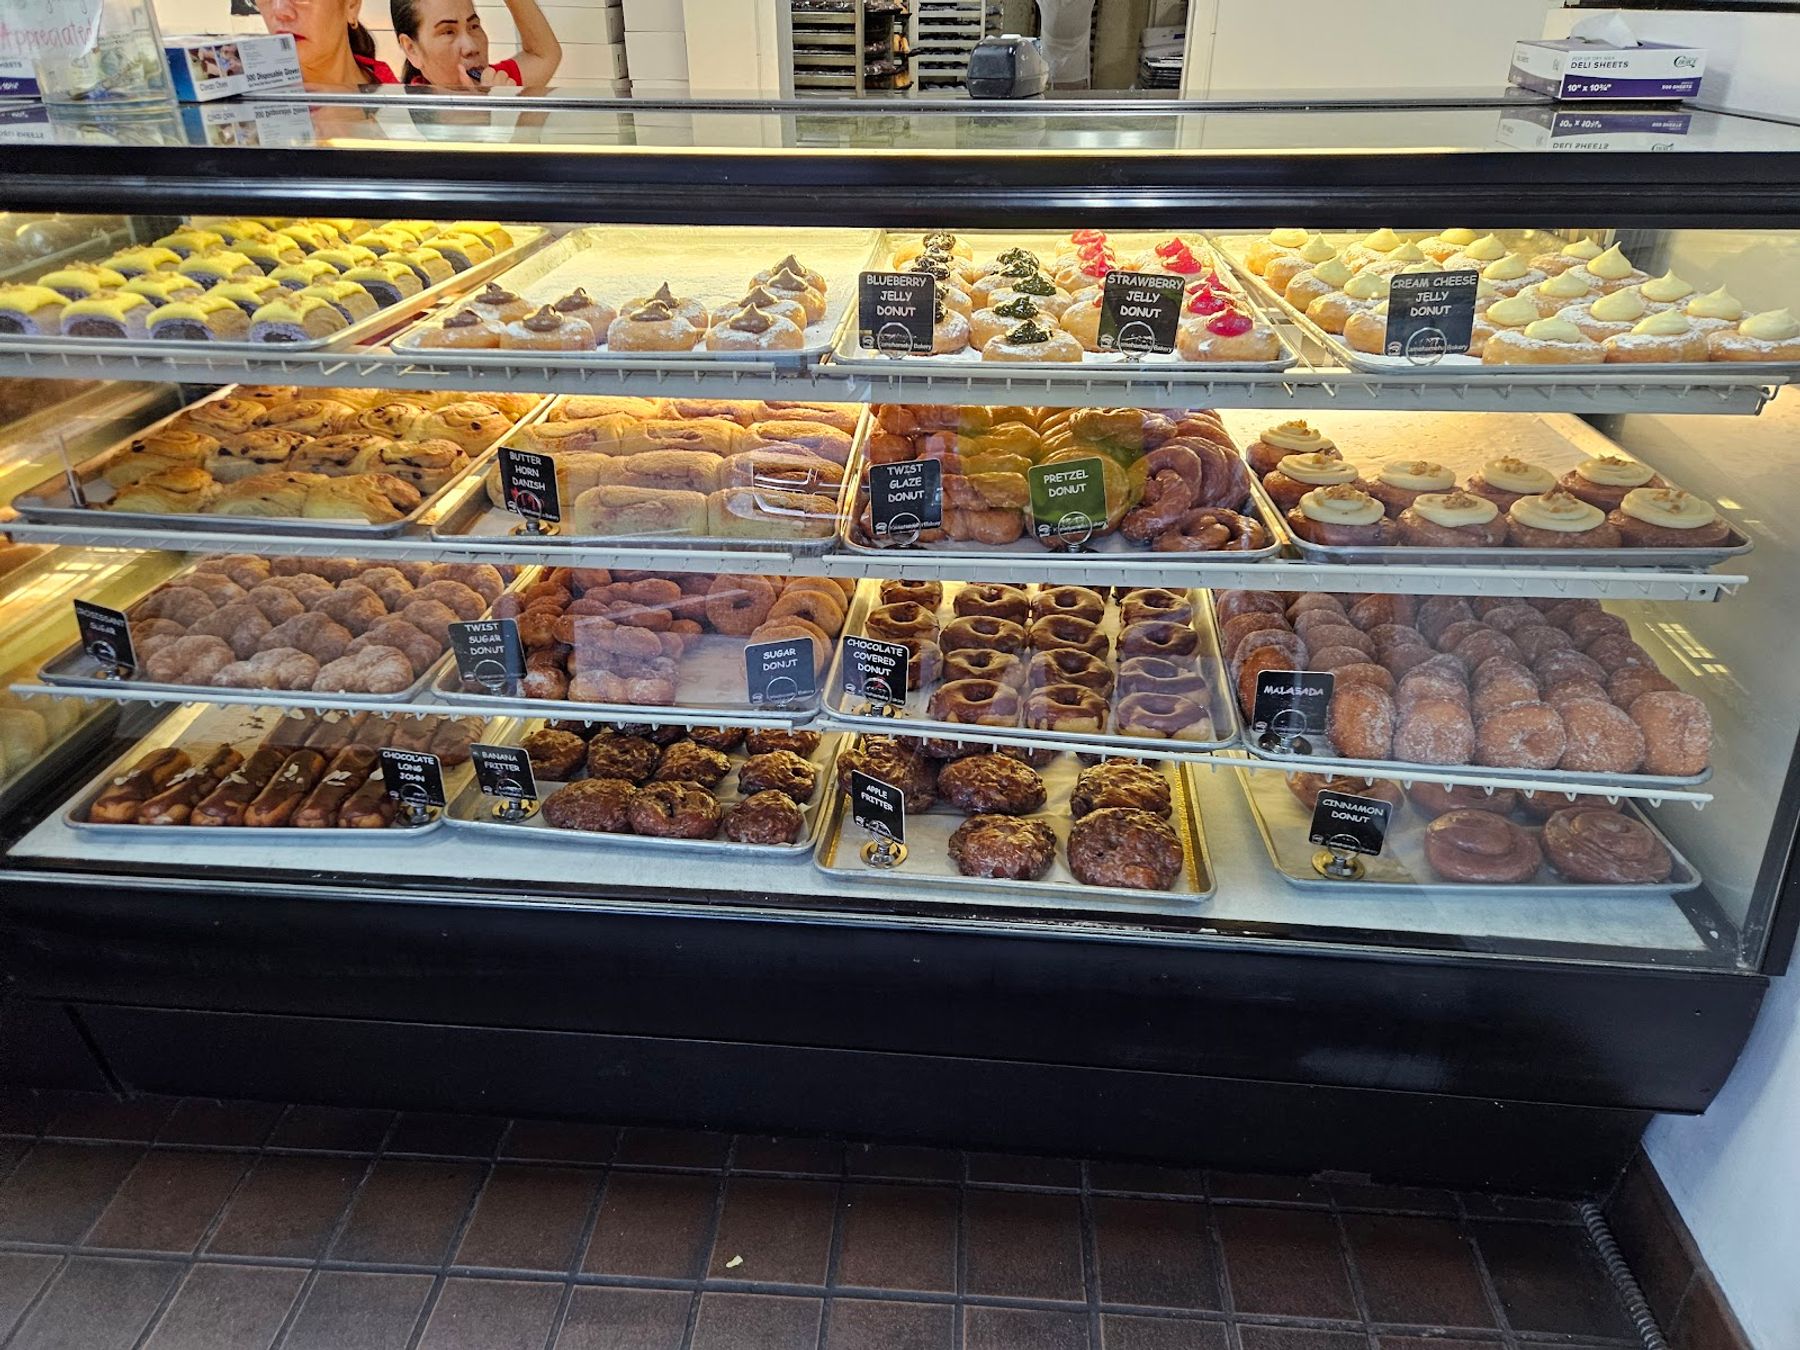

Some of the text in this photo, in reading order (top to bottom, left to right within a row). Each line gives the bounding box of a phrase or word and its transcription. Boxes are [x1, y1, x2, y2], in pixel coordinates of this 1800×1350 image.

[1571, 61, 1629, 69] DELI SHEETS
[867, 275, 926, 287] BLUEBERRY
[1107, 274, 1184, 290] STRAWBERRY
[1391, 275, 1477, 289] CREAM CHEESE
[880, 290, 912, 302] JELLY
[1126, 290, 1160, 303] JELLY
[1416, 291, 1449, 302] JELLY
[876, 305, 916, 317] DONUT
[1120, 305, 1162, 319] DONUT
[1410, 305, 1452, 317] DONUT
[509, 451, 542, 465] BUTTER
[515, 465, 540, 477] HORN
[887, 464, 923, 475] TWIST
[1043, 469, 1089, 484] PRETZEL
[512, 476, 546, 491] DANISH
[889, 477, 922, 489] GLAZE
[1048, 483, 1087, 497] DONUT
[887, 490, 925, 503] DONUT
[464, 623, 499, 632] TWIST
[468, 634, 502, 644] SUGAR
[470, 645, 505, 655] DONUT
[847, 638, 904, 657] CHOCOLATE
[763, 648, 796, 660] SUGAR
[853, 651, 896, 667] COVERED
[763, 658, 798, 671] DONUT
[857, 662, 892, 676] DONUT
[1263, 685, 1324, 696] MALASADA
[382, 751, 435, 765] CHOCOLATE
[482, 751, 518, 762] BANANA
[397, 762, 423, 773] LONG
[484, 761, 521, 772] FRITTER
[399, 772, 425, 782] JOHN
[866, 785, 888, 799] APPLE
[860, 792, 893, 812] FRITTER
[1322, 799, 1384, 816] CINNAMON
[1331, 810, 1371, 823] DONUT
